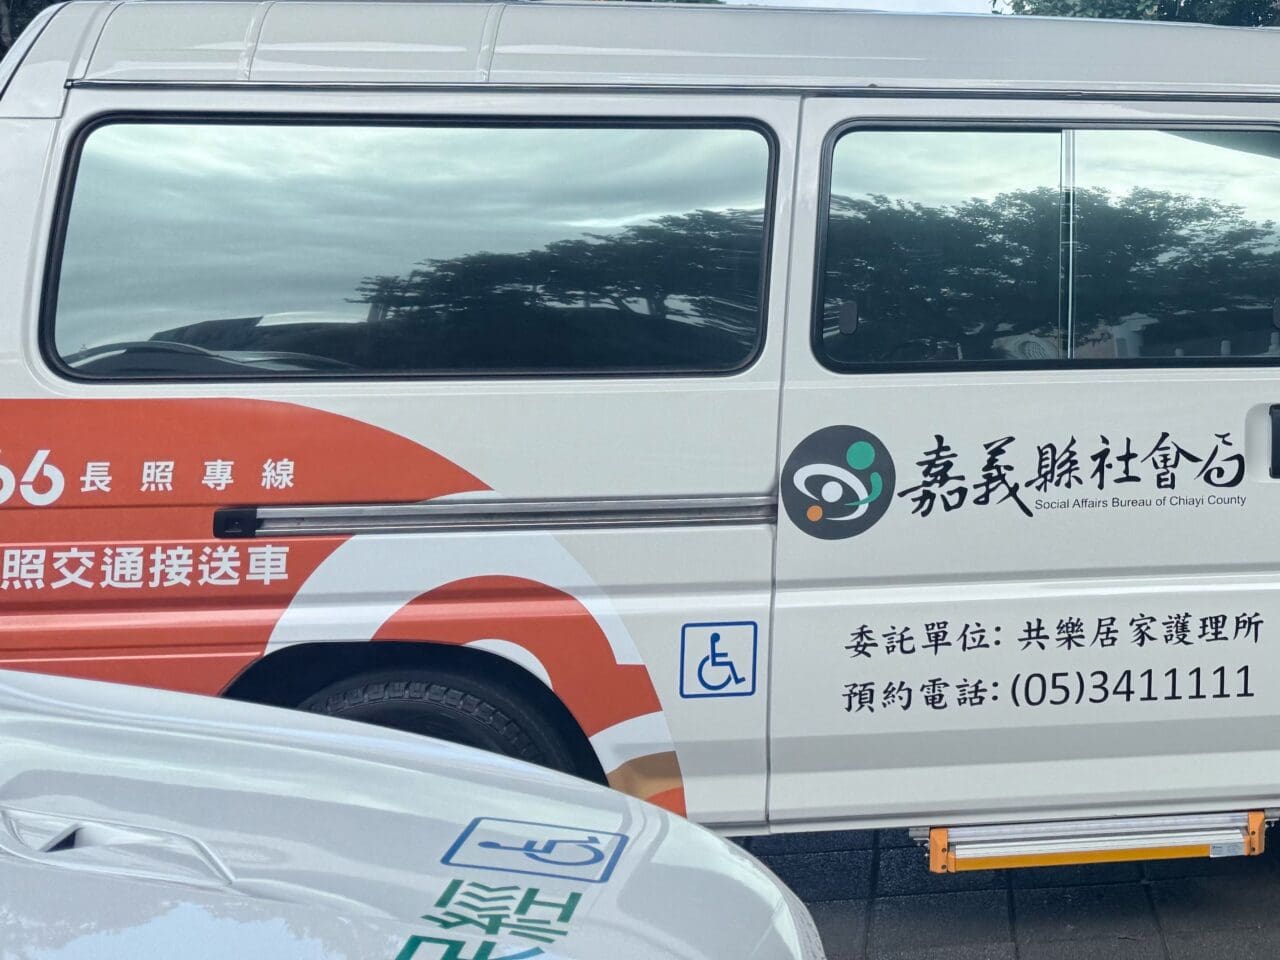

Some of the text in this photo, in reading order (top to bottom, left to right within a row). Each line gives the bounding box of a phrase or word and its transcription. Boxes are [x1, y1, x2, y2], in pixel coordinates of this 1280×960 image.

[80, 458, 296, 493] 長照專線
[897, 431, 1246, 518] 嘉義縣社會局
[1035, 494, 1247, 509] Social Affairs Bureau of Chiayi County
[0, 544, 290, 590] 照交通接送車
[1016, 611, 1265, 651] 共樂居家護理所
[1010, 665, 1255, 707] (05)3411111
